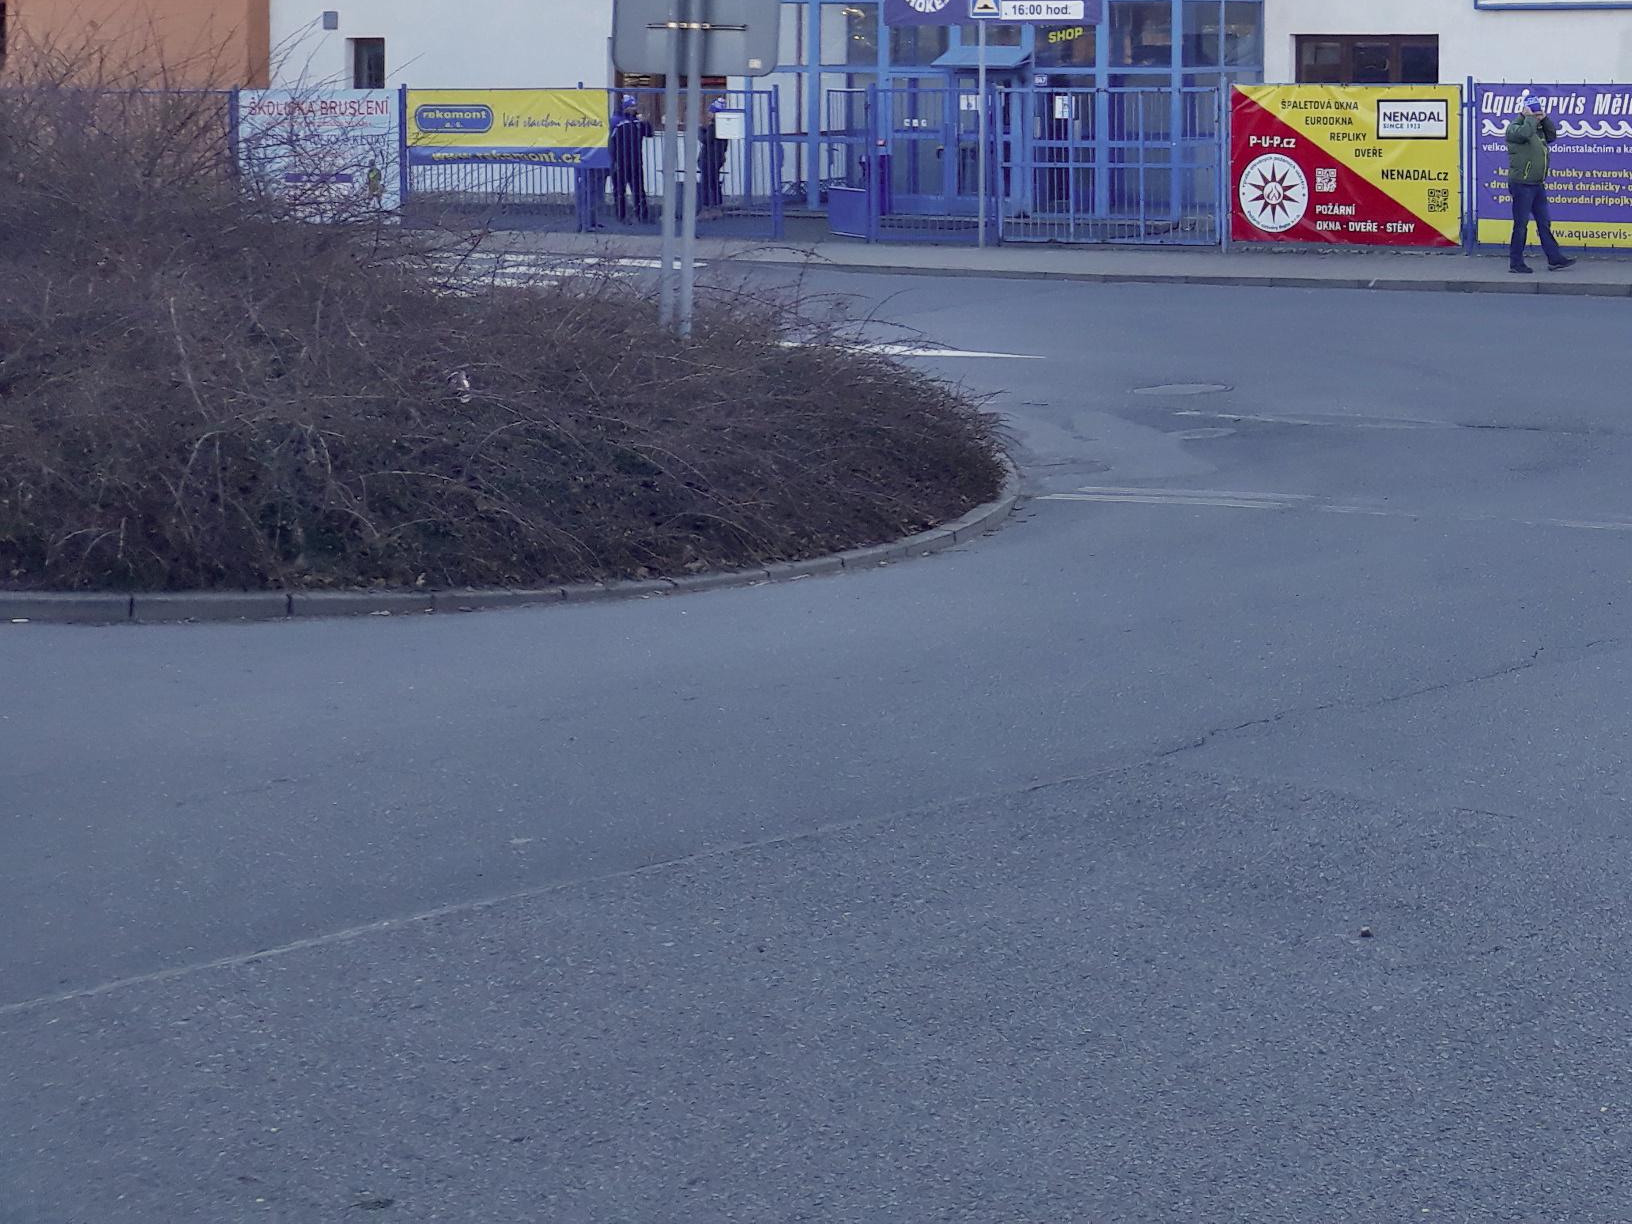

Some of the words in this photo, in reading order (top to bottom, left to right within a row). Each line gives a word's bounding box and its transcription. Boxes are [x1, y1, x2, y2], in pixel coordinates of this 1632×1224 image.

[1012, 1, 1042, 16] 16:00
[1045, 1, 1072, 16] hod.
[1047, 26, 1084, 44] SHOP
[320, 95, 390, 116] BRUSLENÍ
[1281, 99, 1332, 110] ŠPALETOVÁ
[1334, 100, 1359, 110] OKNA
[1305, 116, 1354, 126] EUROOKNA
[1383, 111, 1444, 123] NENADAL
[1249, 135, 1296, 149] P-U-P.cz
[1329, 132, 1367, 142] REPLIKY
[1354, 147, 1383, 158] DVEŘE
[1550, 144, 1614, 154] doinstalačním
[1381, 169, 1449, 181] NENADAL.cz
[1552, 169, 1584, 180] trubky
[1545, 181, 1574, 191] elové
[1575, 181, 1620, 193] chráničky
[1547, 195, 1594, 205] odovodní
[1315, 203, 1356, 216] POŽÁRNÍ
[1316, 220, 1341, 231] OKNA
[1349, 219, 1378, 232] DVEŘE
[1386, 220, 1415, 233] STĚNY
